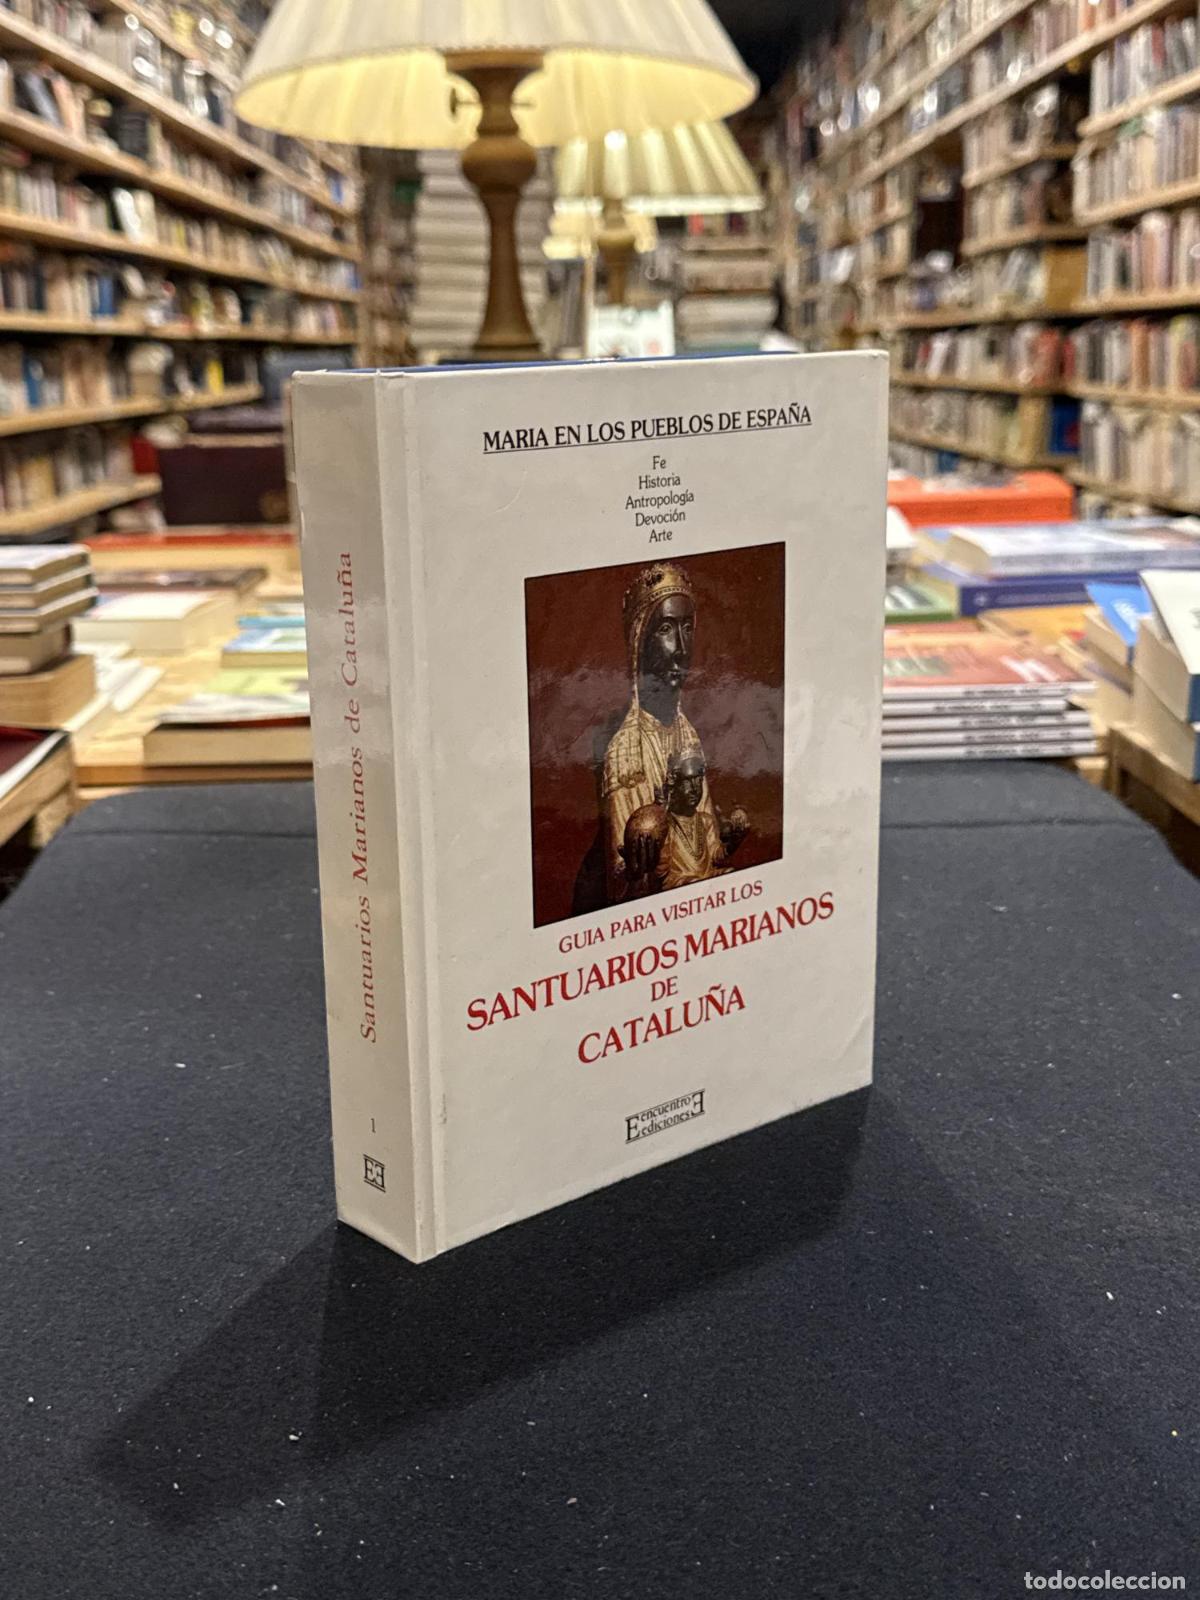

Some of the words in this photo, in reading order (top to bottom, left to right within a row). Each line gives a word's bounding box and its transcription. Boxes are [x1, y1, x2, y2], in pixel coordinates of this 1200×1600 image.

[483, 428, 549, 452] MARIA
[555, 425, 581, 446] EN
[587, 421, 625, 443] LOS
[631, 413, 713, 440] PUEBLOS
[718, 410, 742, 431] DE
[746, 402, 811, 428] ESPAÑA
[638, 473, 681, 490] Historia
[652, 455, 667, 470] Fe
[625, 489, 695, 511] Antropología
[635, 509, 686, 527] Devoción
[649, 529, 673, 544] Arte
[336, 553, 358, 687] Cataluña
[344, 699, 361, 734] de
[350, 747, 369, 884] Marianos
[558, 931, 605, 954] GUIA
[610, 912, 657, 939] PARA
[661, 890, 727, 924] VISITAR
[731, 880, 764, 904] LOS
[355, 895, 377, 1043] Santuarios
[467, 939, 678, 1031] SANTUARIOS
[684, 892, 834, 963] MARIANOS
[650, 976, 678, 1002] DE
[577, 983, 746, 1064] CATALUÑA
